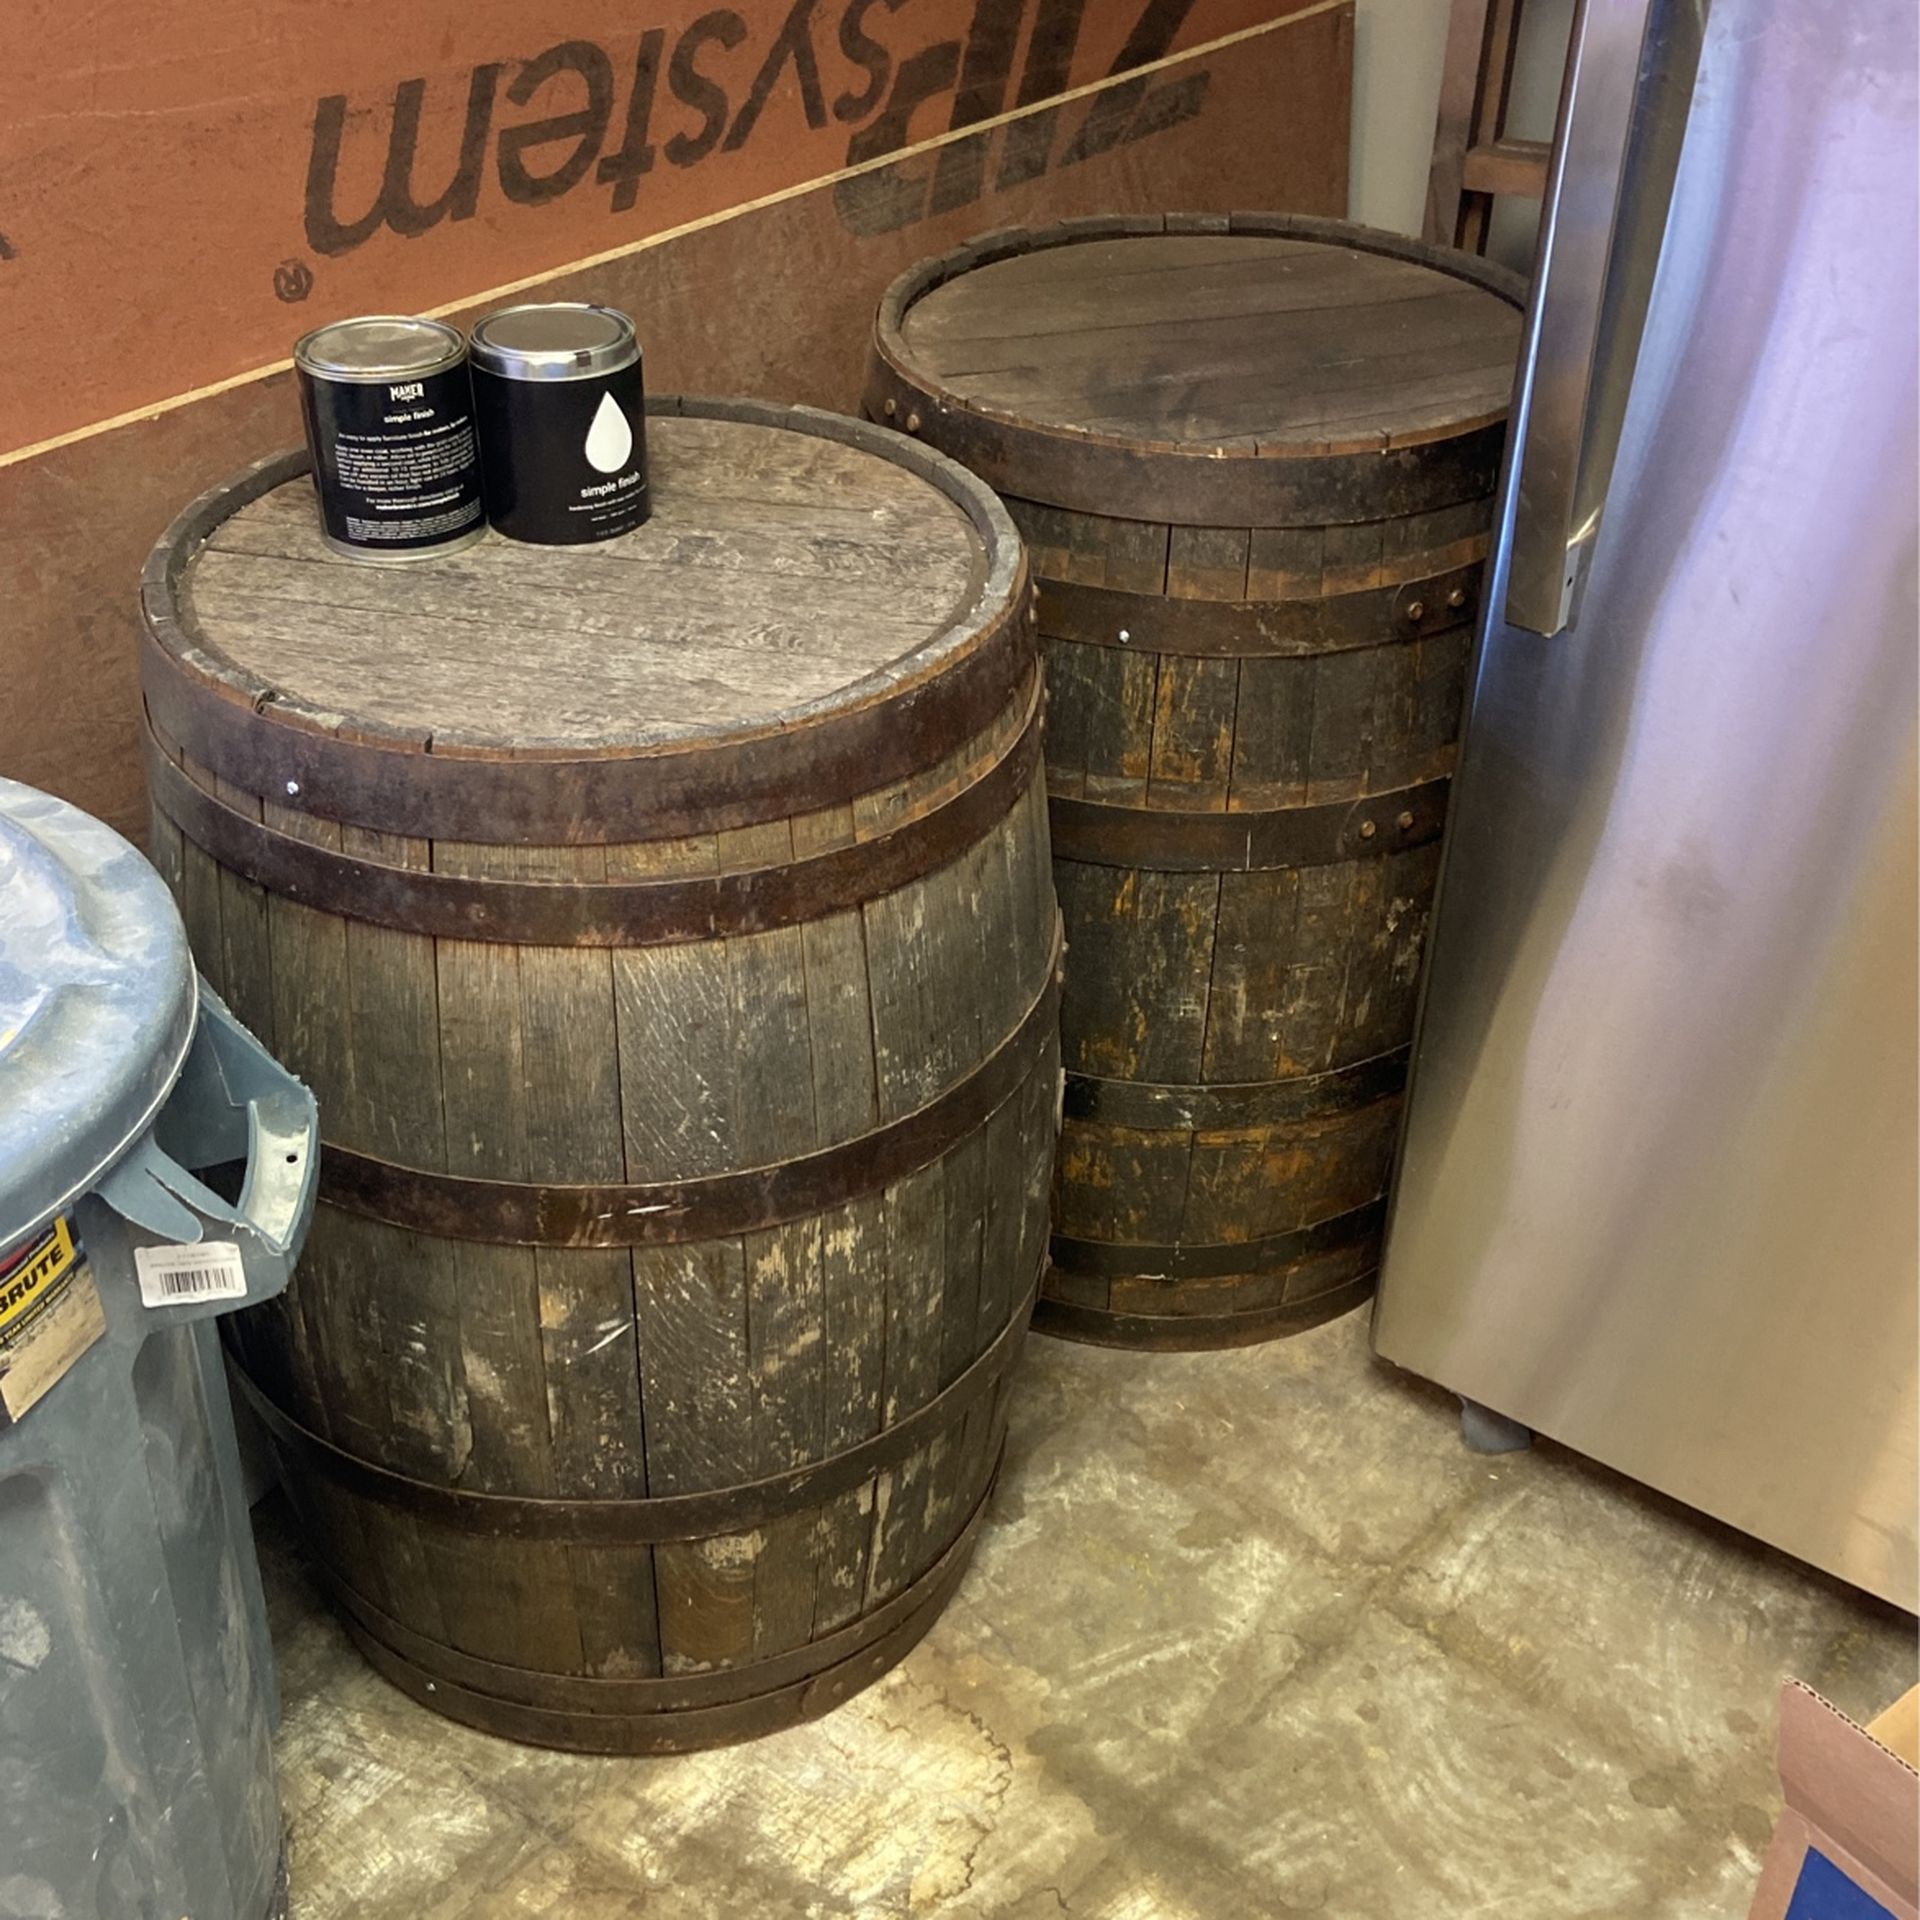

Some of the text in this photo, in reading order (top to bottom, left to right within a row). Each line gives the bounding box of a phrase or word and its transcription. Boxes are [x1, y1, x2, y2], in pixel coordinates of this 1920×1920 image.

[304, 0, 910, 258] system
[383, 409, 435, 423] simple finish
[581, 471, 641, 498] simple finish
[0, 1243, 64, 1314] BRUTE
